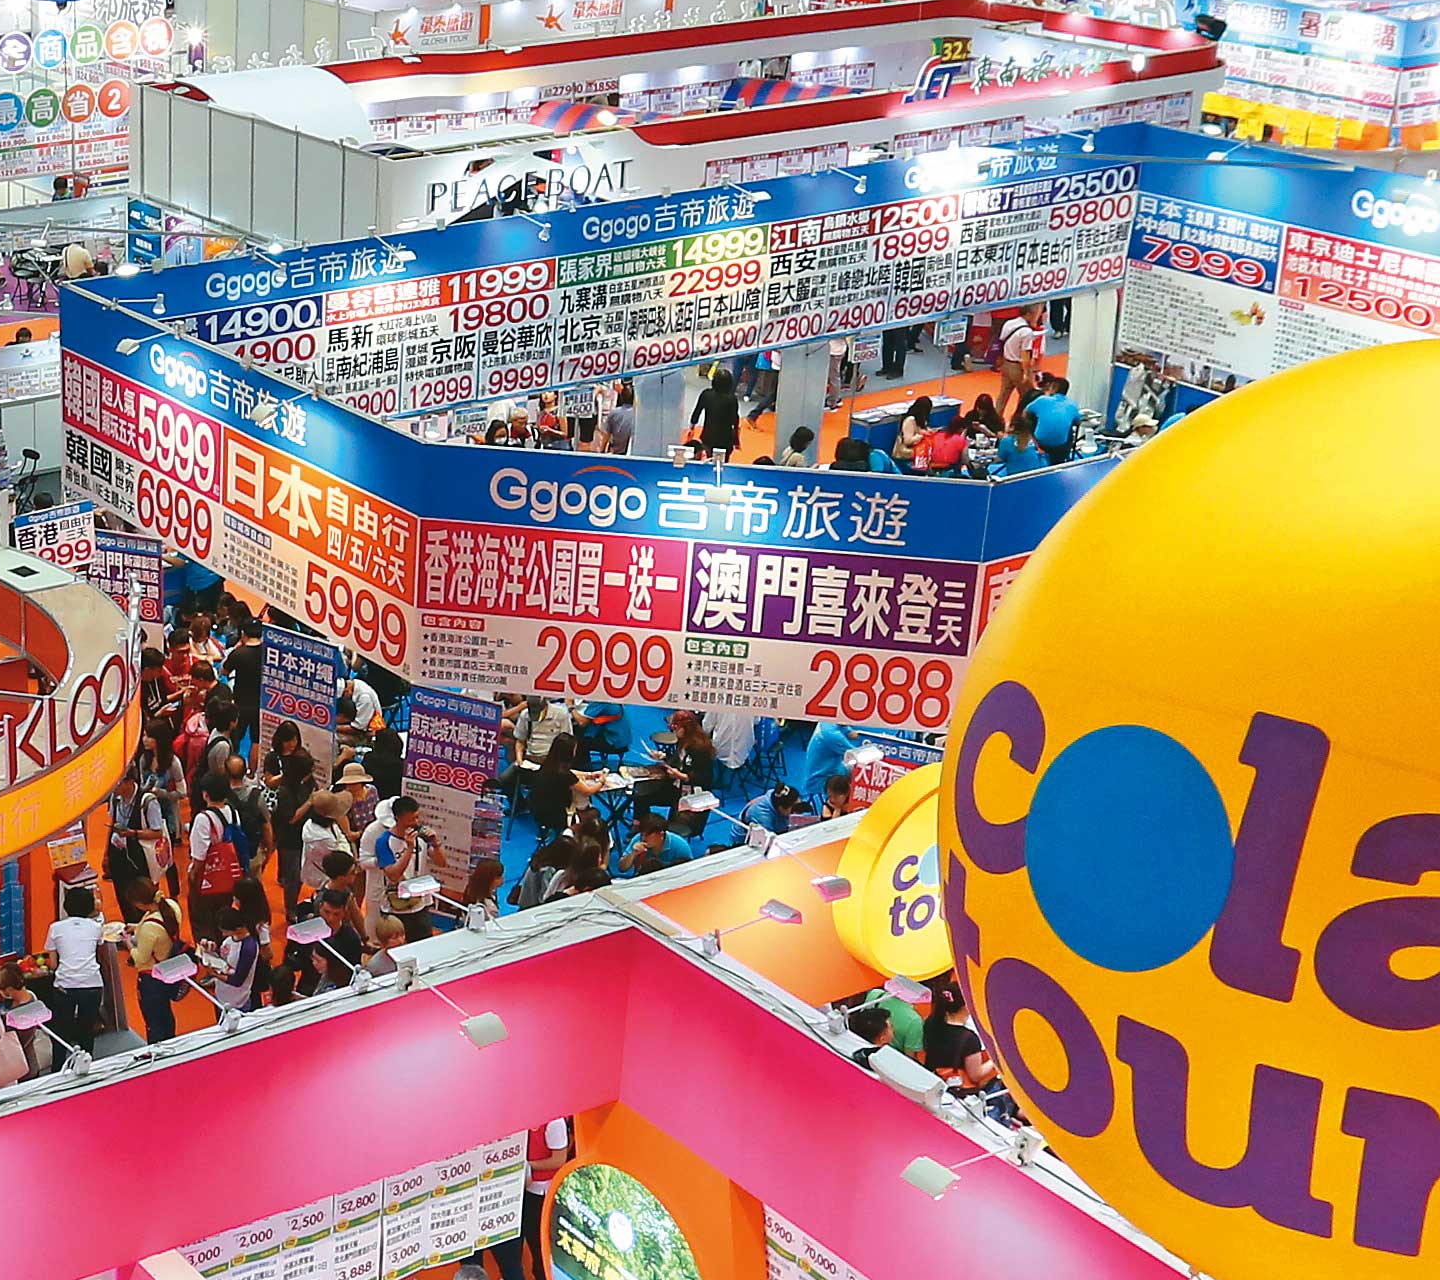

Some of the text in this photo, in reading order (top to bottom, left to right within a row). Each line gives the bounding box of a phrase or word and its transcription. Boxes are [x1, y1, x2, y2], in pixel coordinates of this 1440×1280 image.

[429, 158, 634, 214] PEACE BOAT
[1052, 166, 1136, 203] 25500
[1138, 195, 1183, 221] 日本
[583, 193, 756, 244] Ggogo 吉帝旅遊
[771, 197, 956, 251] 江南 12500
[1048, 194, 1133, 231] 59800
[1351, 189, 1440, 236] Ggogo
[290, 241, 409, 289] 吉帝旅遊
[558, 225, 765, 285] 張家界 14999
[771, 226, 950, 277] 西安 18999
[955, 240, 1012, 269] 日本東北
[1015, 236, 1073, 271] 日本自由行
[1076, 255, 1124, 286] 7999
[1140, 235, 1266, 287] 7999
[449, 261, 547, 299] 11999
[559, 260, 763, 315] 九寨溝 22999
[697, 288, 761, 320] 日本山陰
[1020, 267, 1068, 297] 5999
[1293, 276, 1435, 330] 12500
[205, 300, 318, 342] 14900
[326, 322, 374, 352] 馬新
[448, 292, 552, 333] 19800
[558, 314, 603, 342] 北京
[894, 291, 950, 320] 6999
[149, 345, 208, 399] Ggogo
[335, 346, 400, 382] 南紀浦島
[429, 332, 477, 367] 京阪
[633, 338, 690, 369] 6999
[487, 360, 550, 397] 9999
[63, 356, 217, 491] 韓國 5999
[65, 430, 213, 561] 韓國 6999
[225, 435, 323, 540] 日本
[491, 467, 910, 548] Ggogo 吉帝旅遊
[17, 523, 59, 551] 香港
[325, 485, 410, 555] 自由行
[422, 528, 680, 625] 香港海洋公園買一送一
[304, 559, 407, 667] 5999
[534, 626, 673, 702] 2999
[803, 649, 953, 724] 2888
[264, 688, 331, 726] 7999
